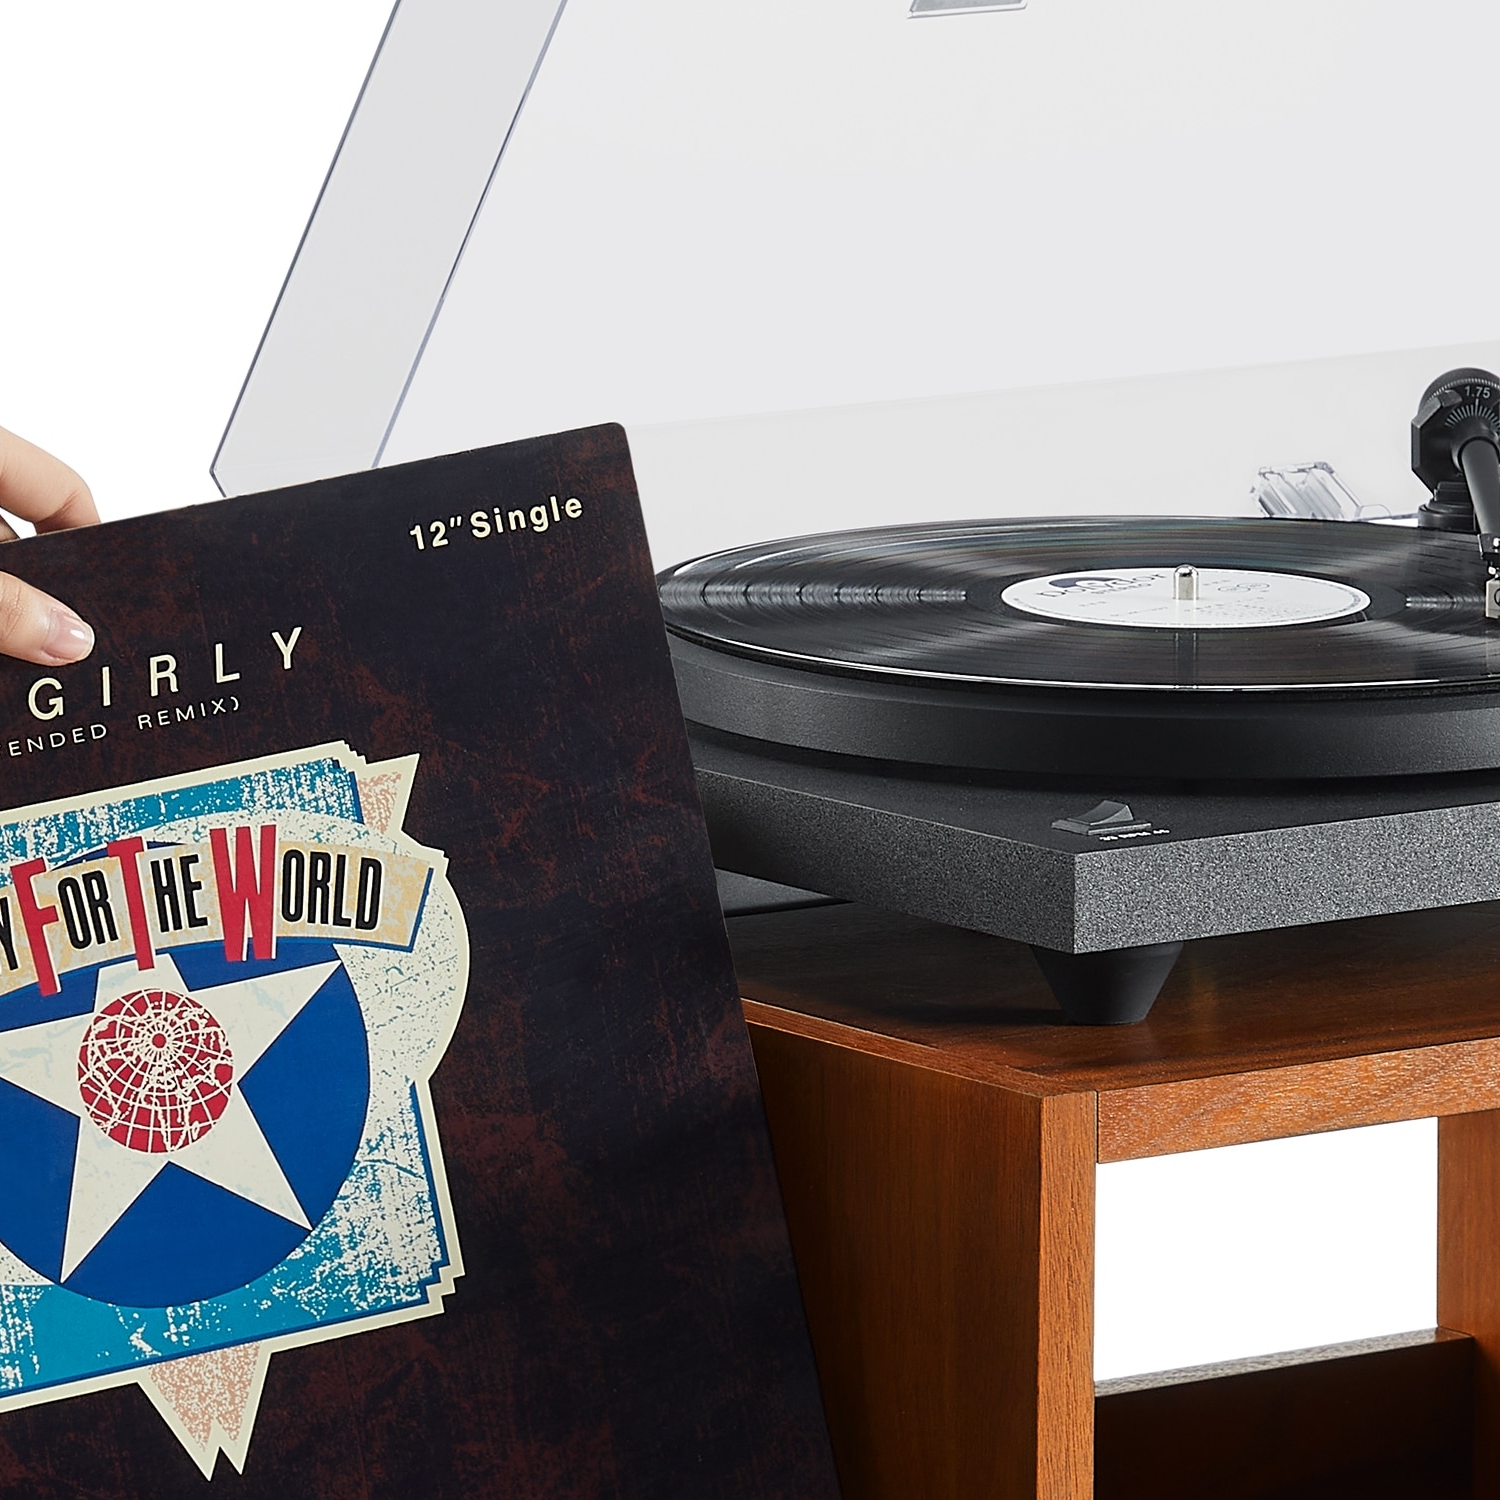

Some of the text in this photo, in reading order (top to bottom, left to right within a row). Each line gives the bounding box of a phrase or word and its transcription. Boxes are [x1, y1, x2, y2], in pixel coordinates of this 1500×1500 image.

[1464, 386, 1491, 399] 1.75
[28, 626, 302, 721] GIRLY
[137, 697, 241, 730] REMIX)
[10, 858, 119, 997] FOR
[107, 836, 206, 971] THE
[210, 824, 382, 961] WORLD
